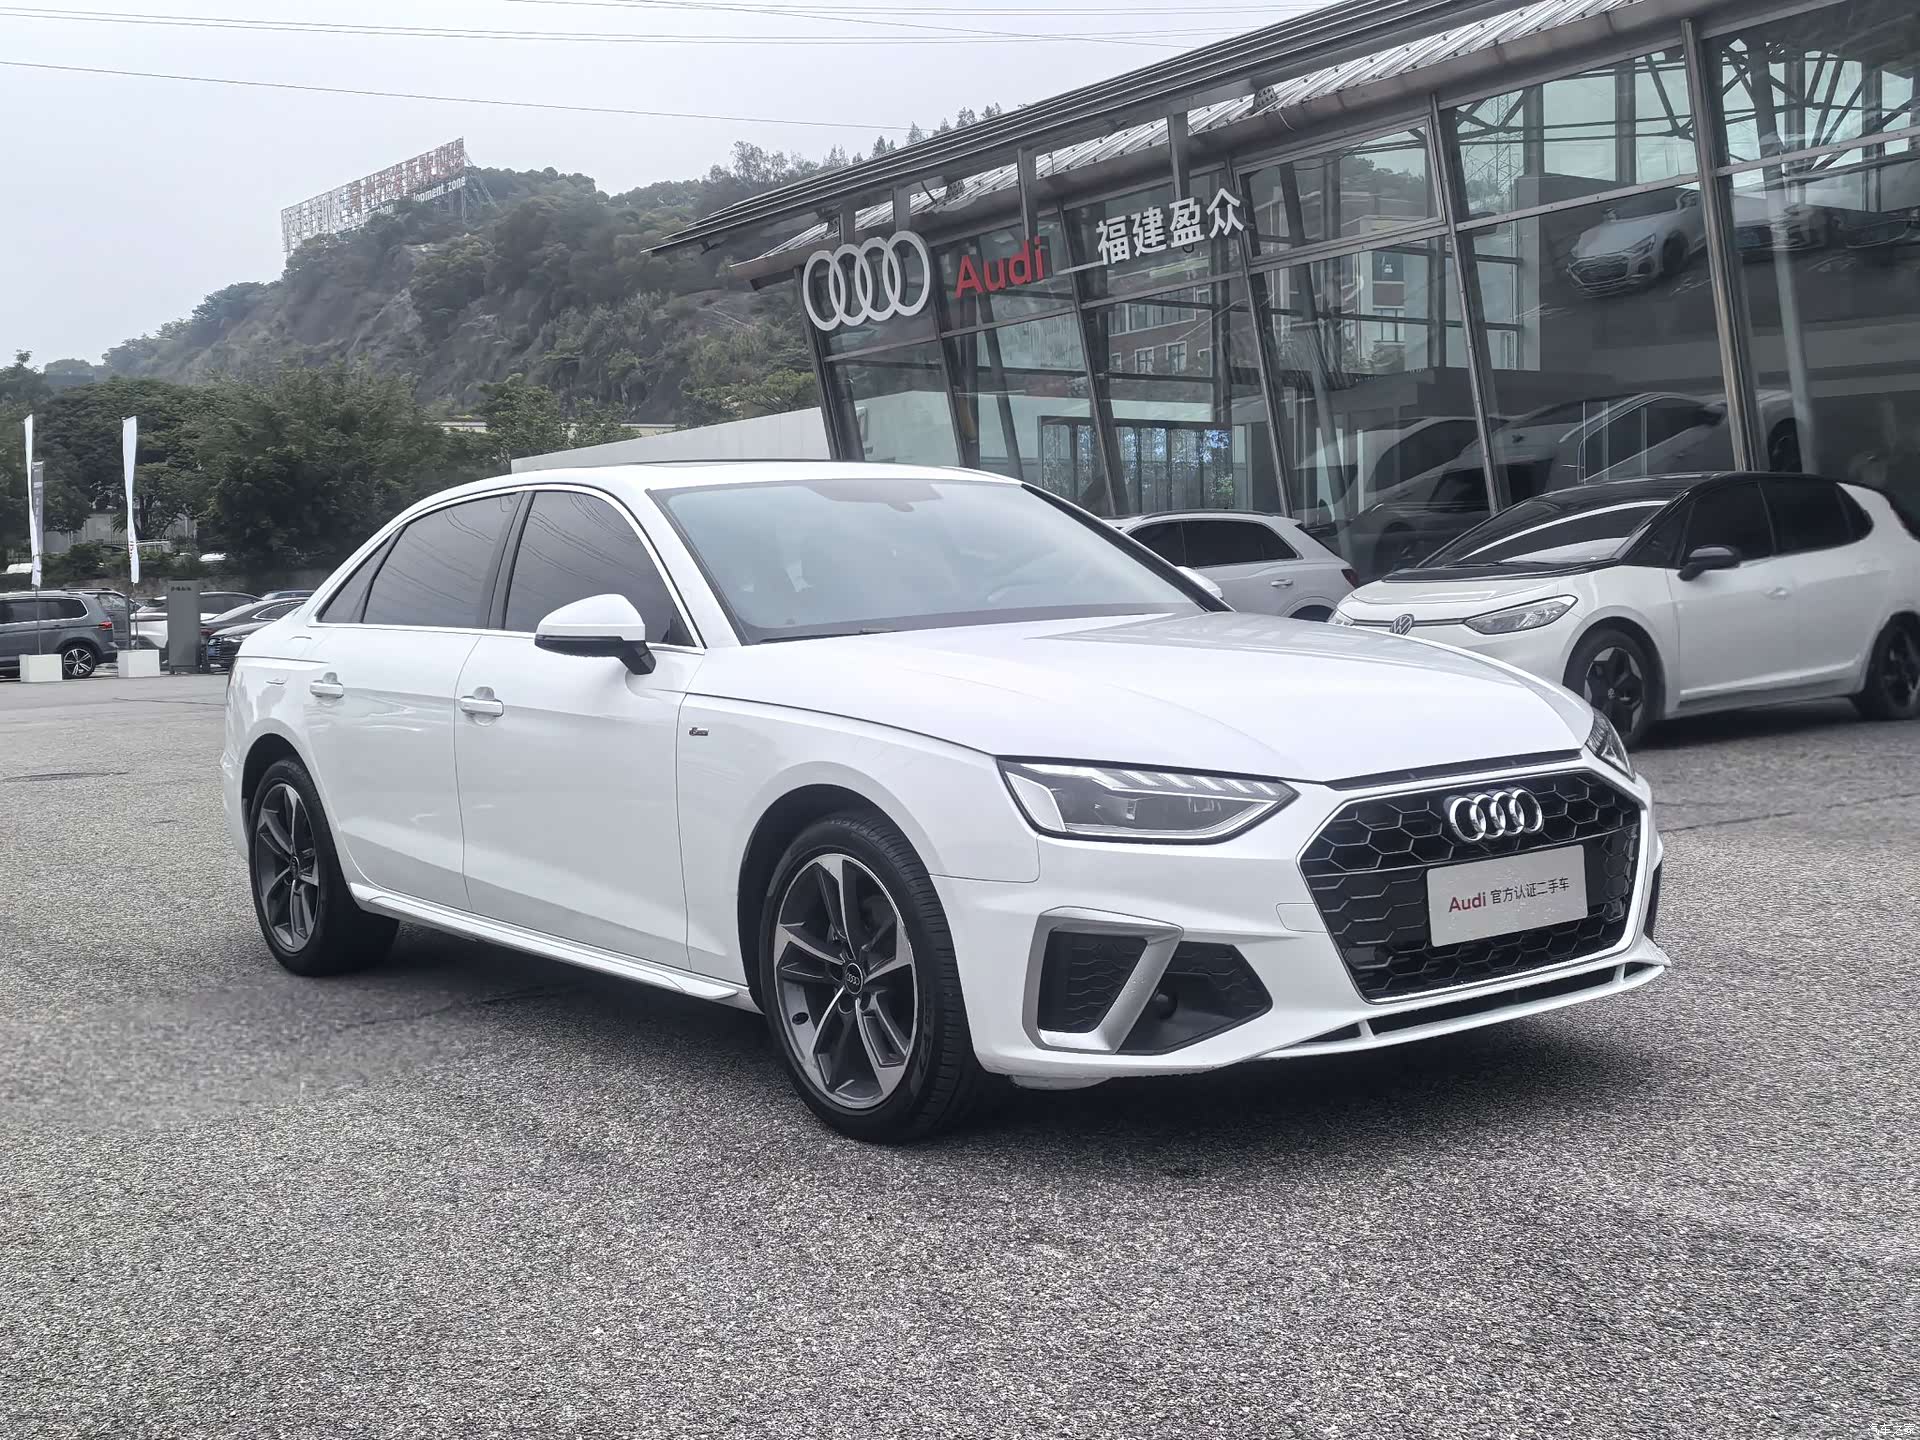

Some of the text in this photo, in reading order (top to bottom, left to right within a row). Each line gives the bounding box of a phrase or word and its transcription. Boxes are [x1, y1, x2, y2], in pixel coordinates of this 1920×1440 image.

[413, 176, 466, 204] lopment zone
[1095, 187, 1245, 266] 福建盈众
[955, 236, 1046, 299] Audi
[1448, 877, 1570, 912] Audi 官方认证二手车
